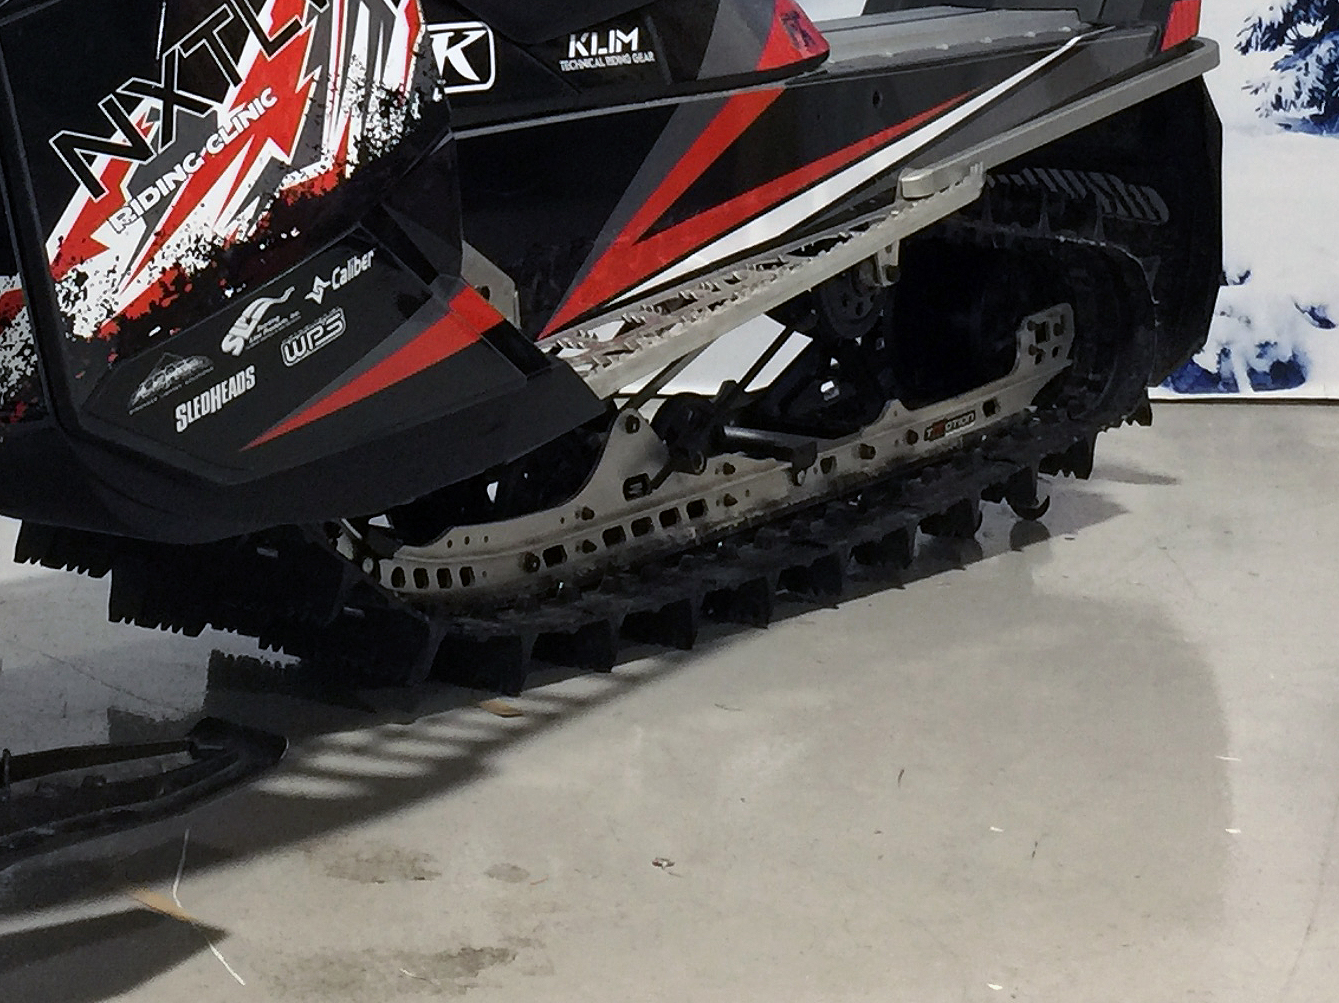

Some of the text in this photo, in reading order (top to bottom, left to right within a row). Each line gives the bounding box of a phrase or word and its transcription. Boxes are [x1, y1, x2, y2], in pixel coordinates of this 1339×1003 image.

[568, 26, 639, 58] KLIM
[108, 86, 278, 234] RIDING CLINIC
[331, 249, 375, 291] Caliber
[283, 311, 344, 363] WPS
[175, 364, 256, 433] SLEDHEADS
